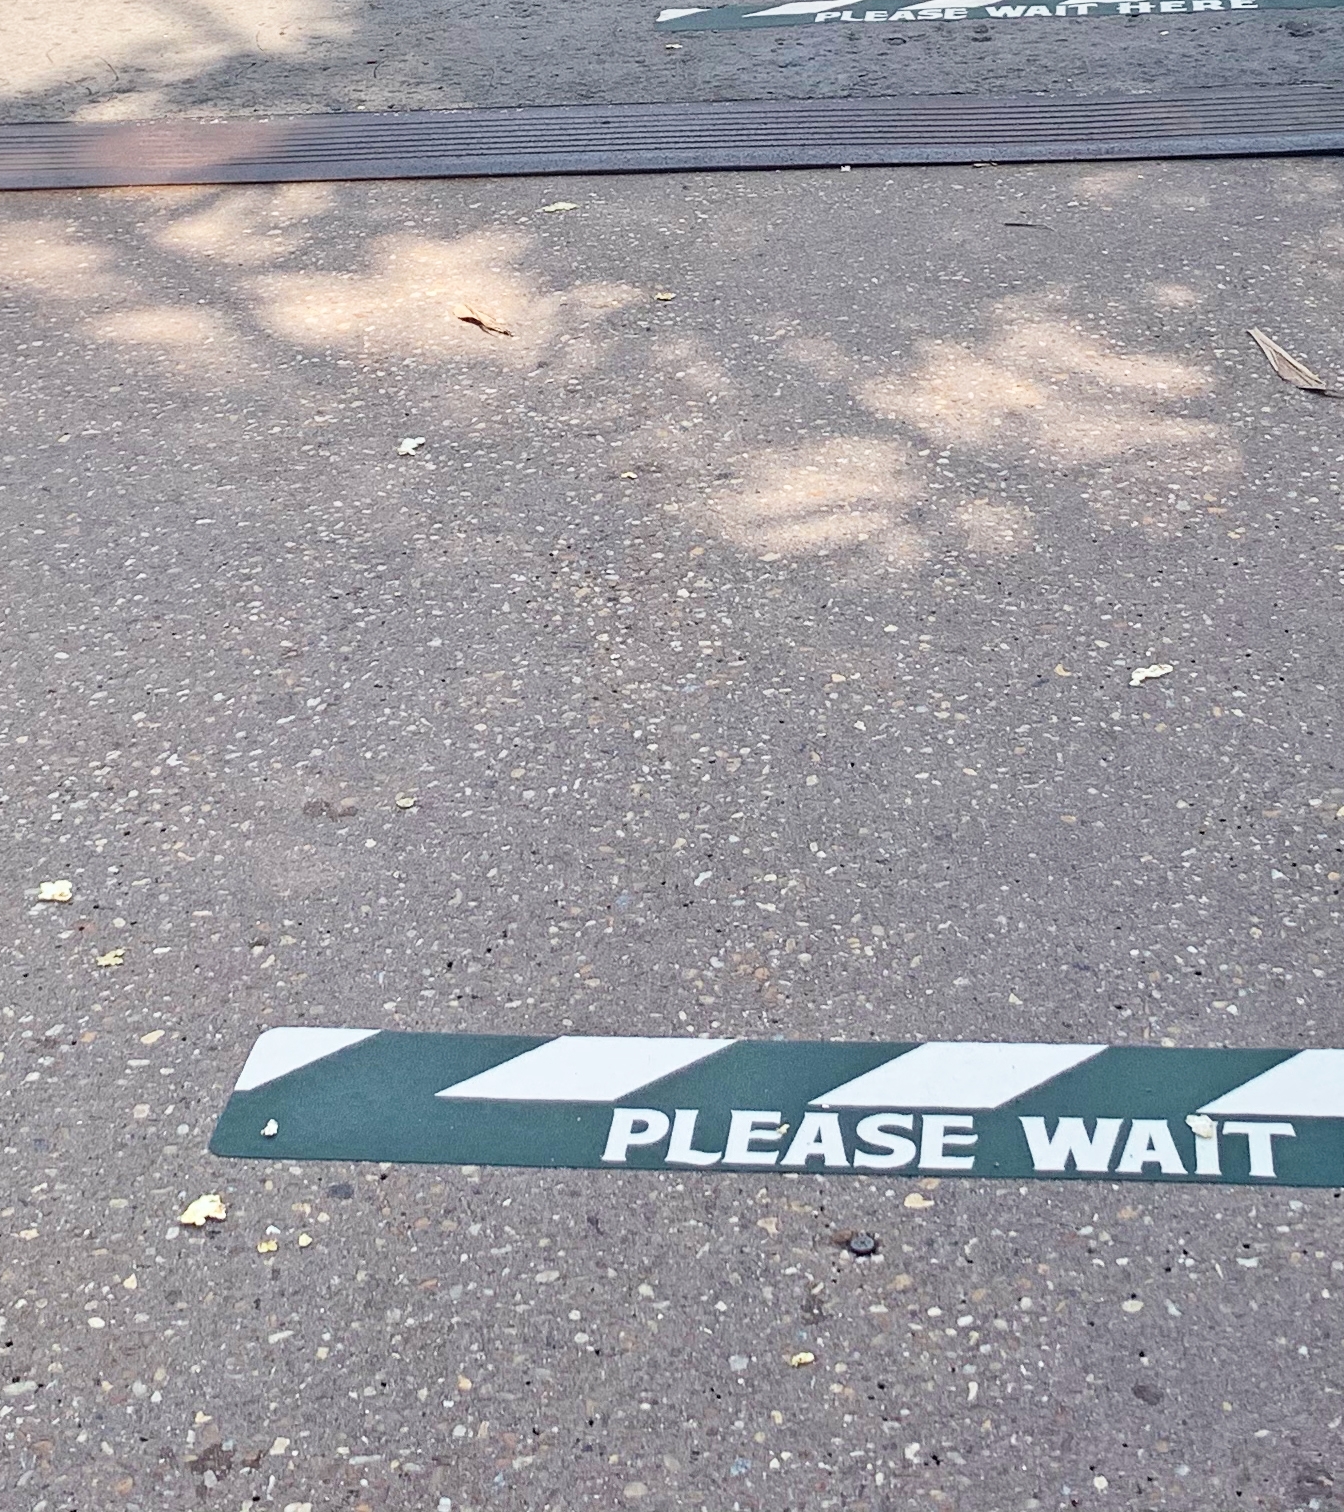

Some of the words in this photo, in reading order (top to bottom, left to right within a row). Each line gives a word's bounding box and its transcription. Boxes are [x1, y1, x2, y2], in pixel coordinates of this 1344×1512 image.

[814, 7, 968, 23] PLEASE
[985, 2, 1098, 19] WAIT
[600, 1107, 979, 1171] PLEASE
[1018, 1115, 1297, 1179] WAIT
